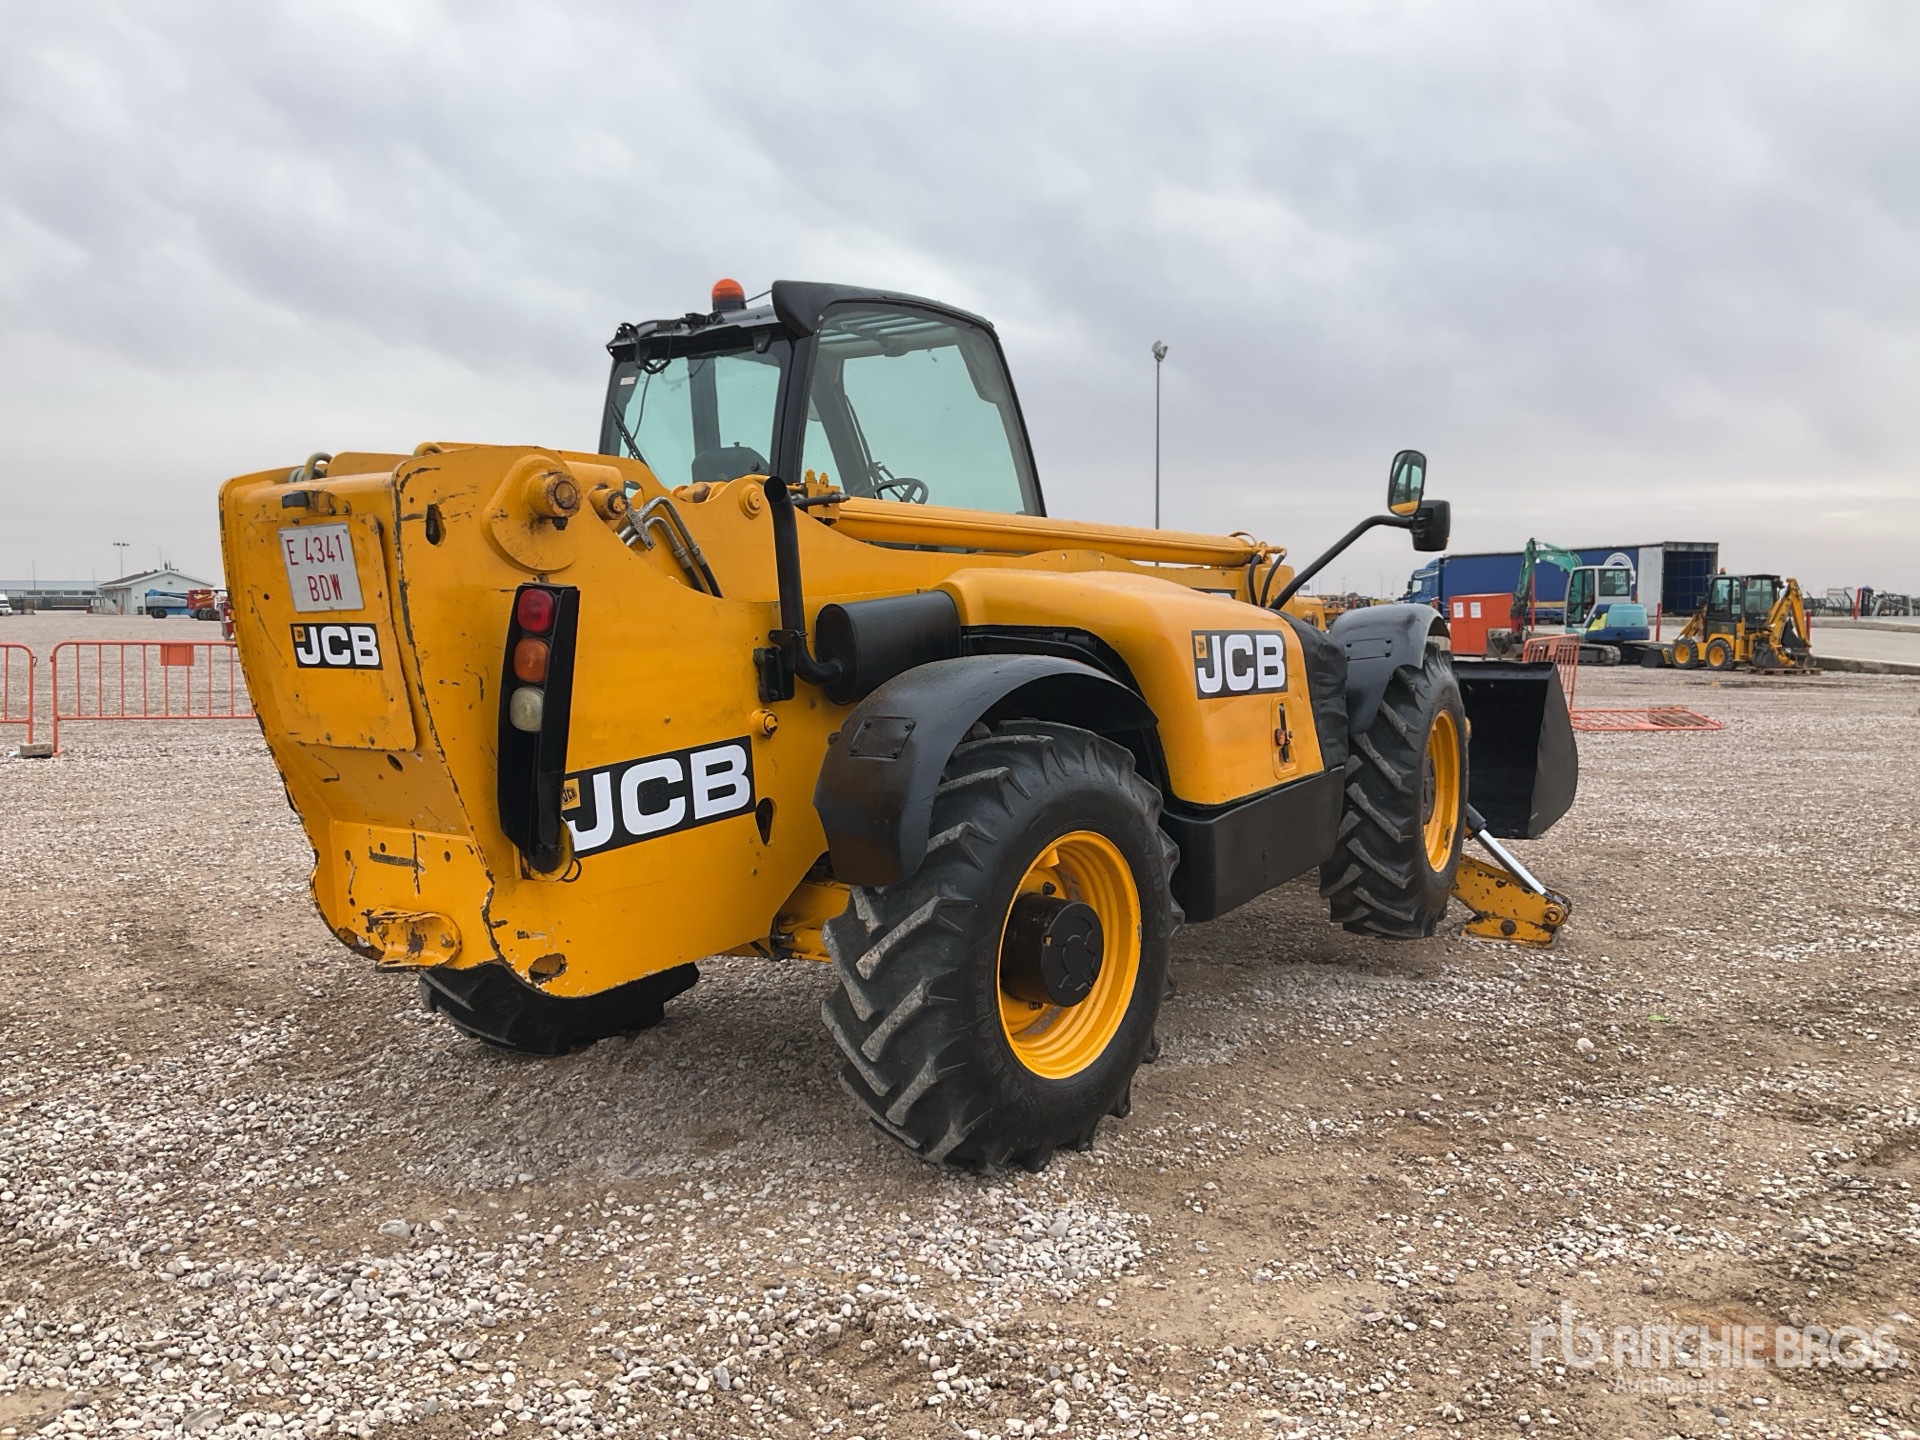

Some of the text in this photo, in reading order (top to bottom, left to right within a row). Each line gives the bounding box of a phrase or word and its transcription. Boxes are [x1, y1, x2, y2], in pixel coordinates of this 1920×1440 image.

[286, 534, 345, 565] E 4341
[307, 574, 343, 602] BDW
[297, 626, 380, 666] JCB
[1197, 634, 1286, 693] JCB
[568, 744, 751, 852] JCB
